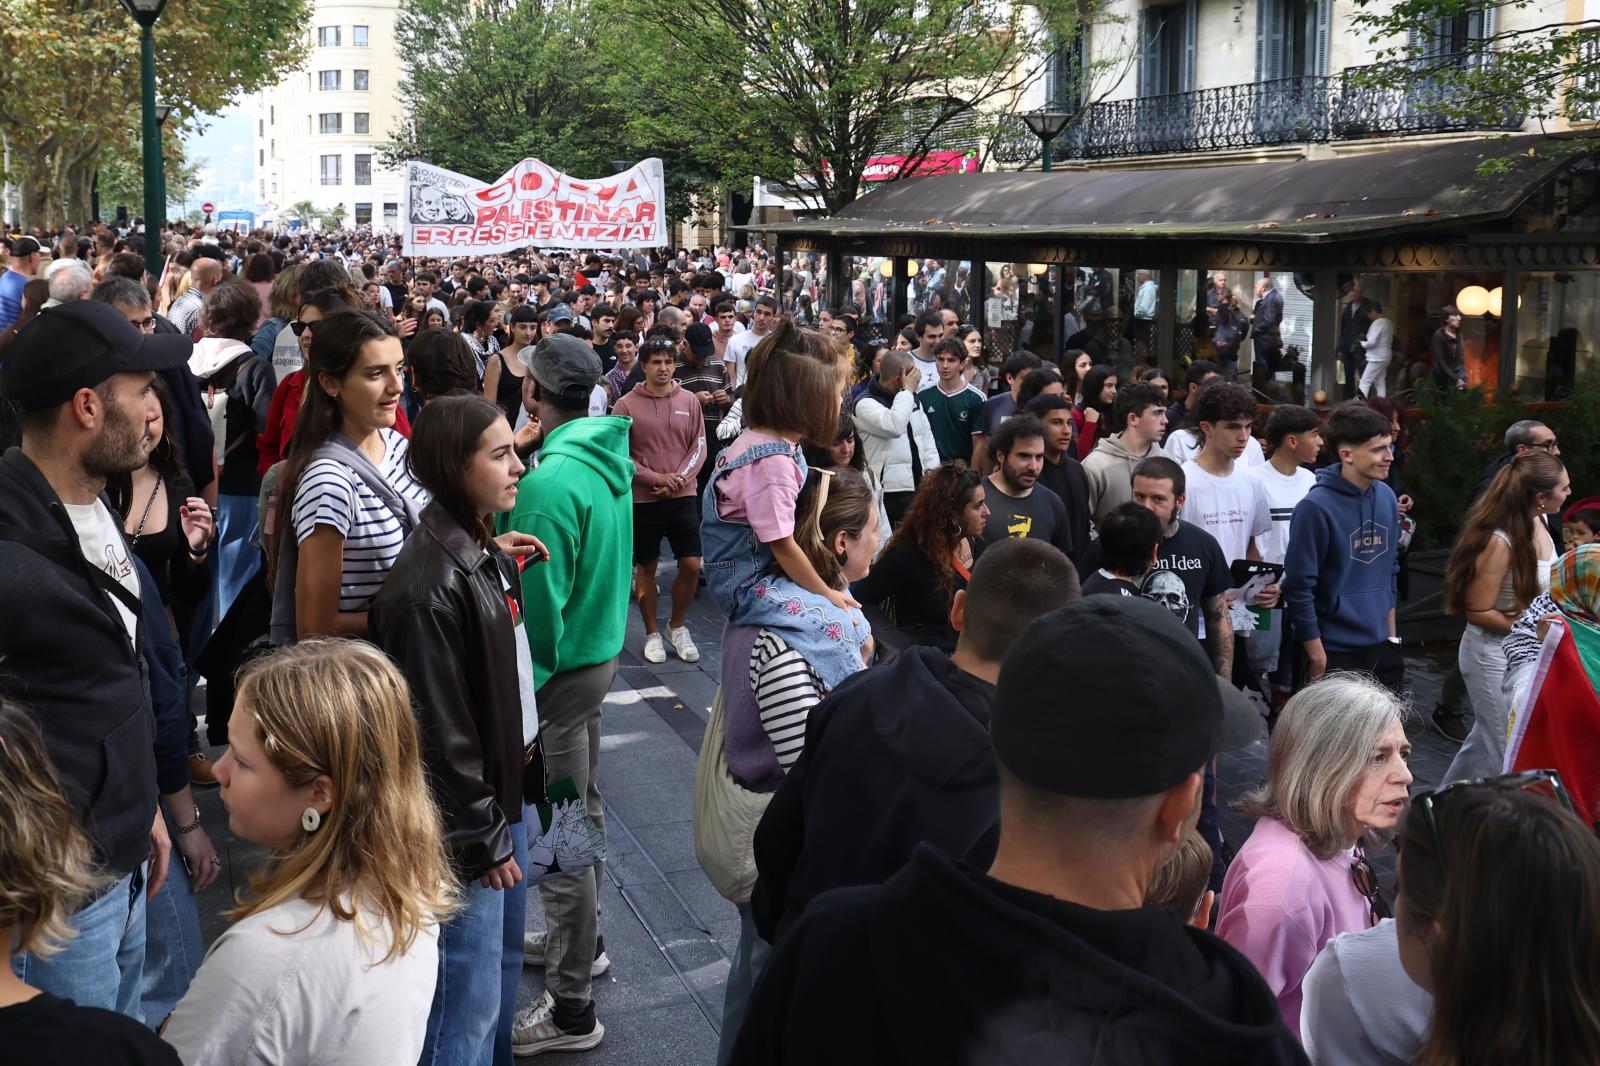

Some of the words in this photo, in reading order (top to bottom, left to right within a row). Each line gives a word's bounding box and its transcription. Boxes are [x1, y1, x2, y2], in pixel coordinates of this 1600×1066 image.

[410, 166, 470, 189] SIONISTEN
[465, 159, 656, 208] GORA
[476, 200, 656, 226] PALESTINAR
[273, 357, 301, 367] atagonia
[1170, 554, 1202, 571] Idea
